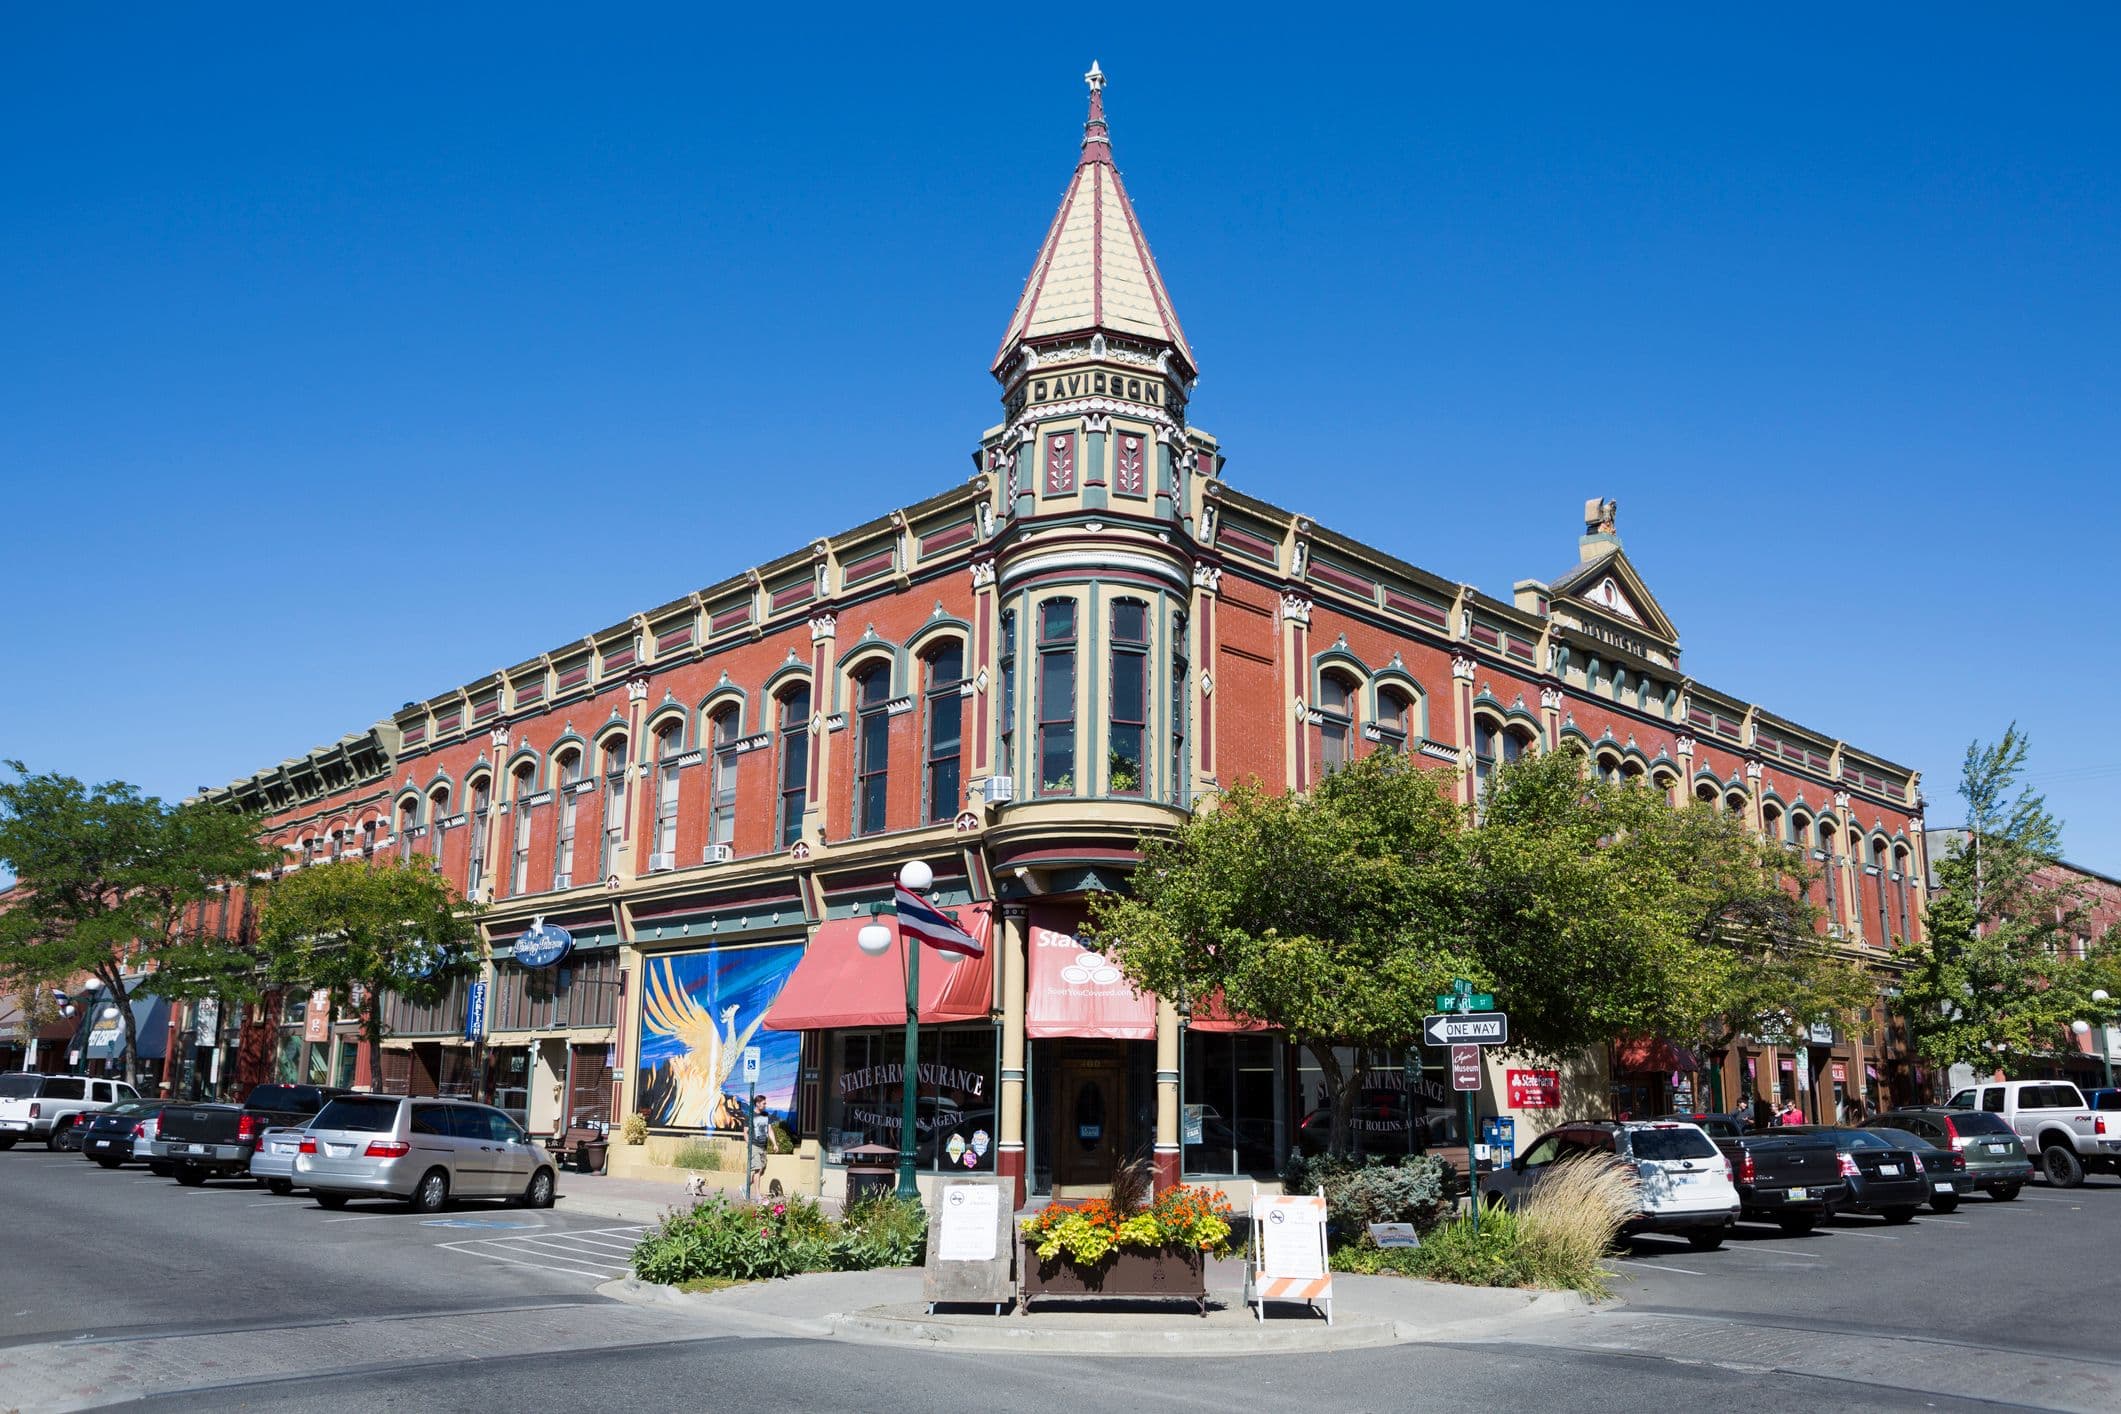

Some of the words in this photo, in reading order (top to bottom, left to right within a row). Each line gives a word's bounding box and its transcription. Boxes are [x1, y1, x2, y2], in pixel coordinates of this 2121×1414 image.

[1034, 372, 1159, 404] DAVIDSON
[1444, 998, 1474, 1009] PEARL
[1446, 1024, 1469, 1036] ONE
[1472, 1023, 1497, 1035] WAY
[1454, 1064, 1478, 1073] Museum
[840, 1068, 872, 1094] STATE
[917, 1063, 984, 1096] NSURANCE
[854, 1109, 883, 1126] SCOTT
[930, 1111, 965, 1128] AGENT
